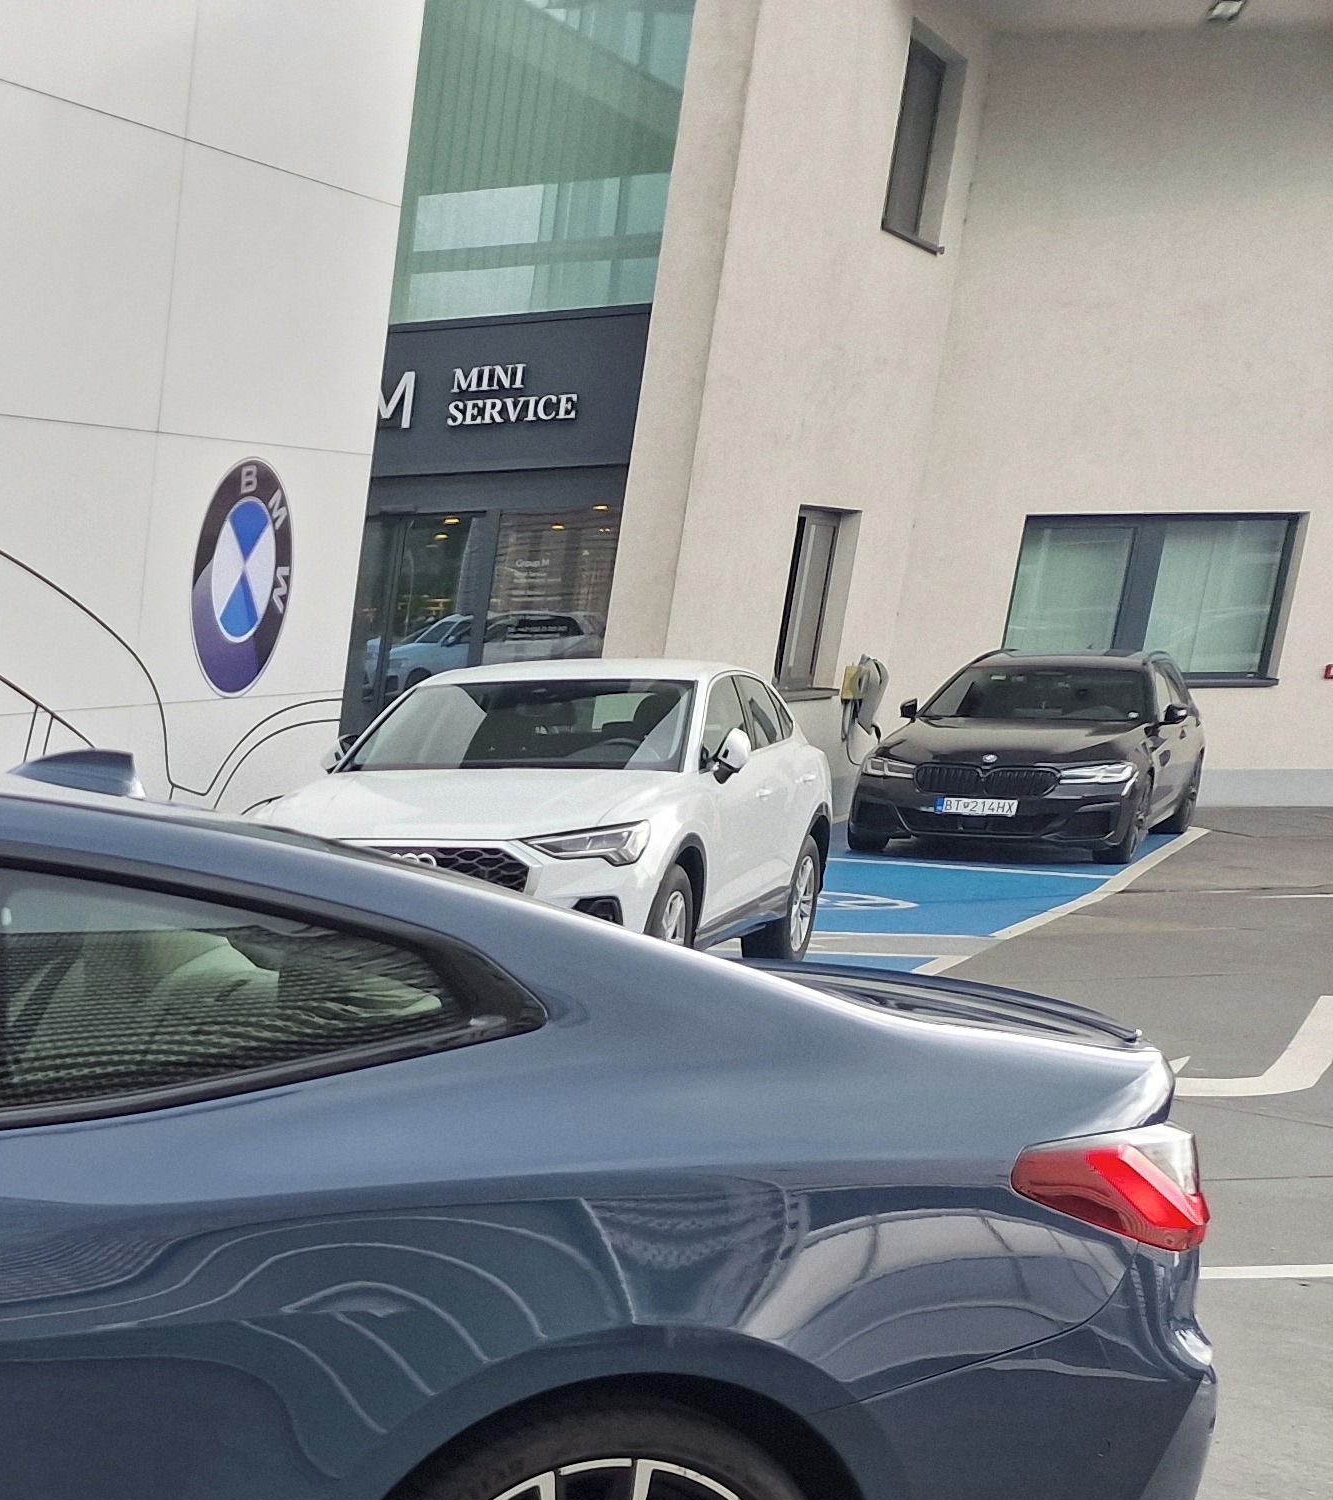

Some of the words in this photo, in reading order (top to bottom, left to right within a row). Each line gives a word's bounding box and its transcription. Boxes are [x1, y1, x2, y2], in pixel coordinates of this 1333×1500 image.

[450, 363, 527, 393] MINI
[446, 393, 578, 427] SERVICE
[240, 464, 290, 614] BMW
